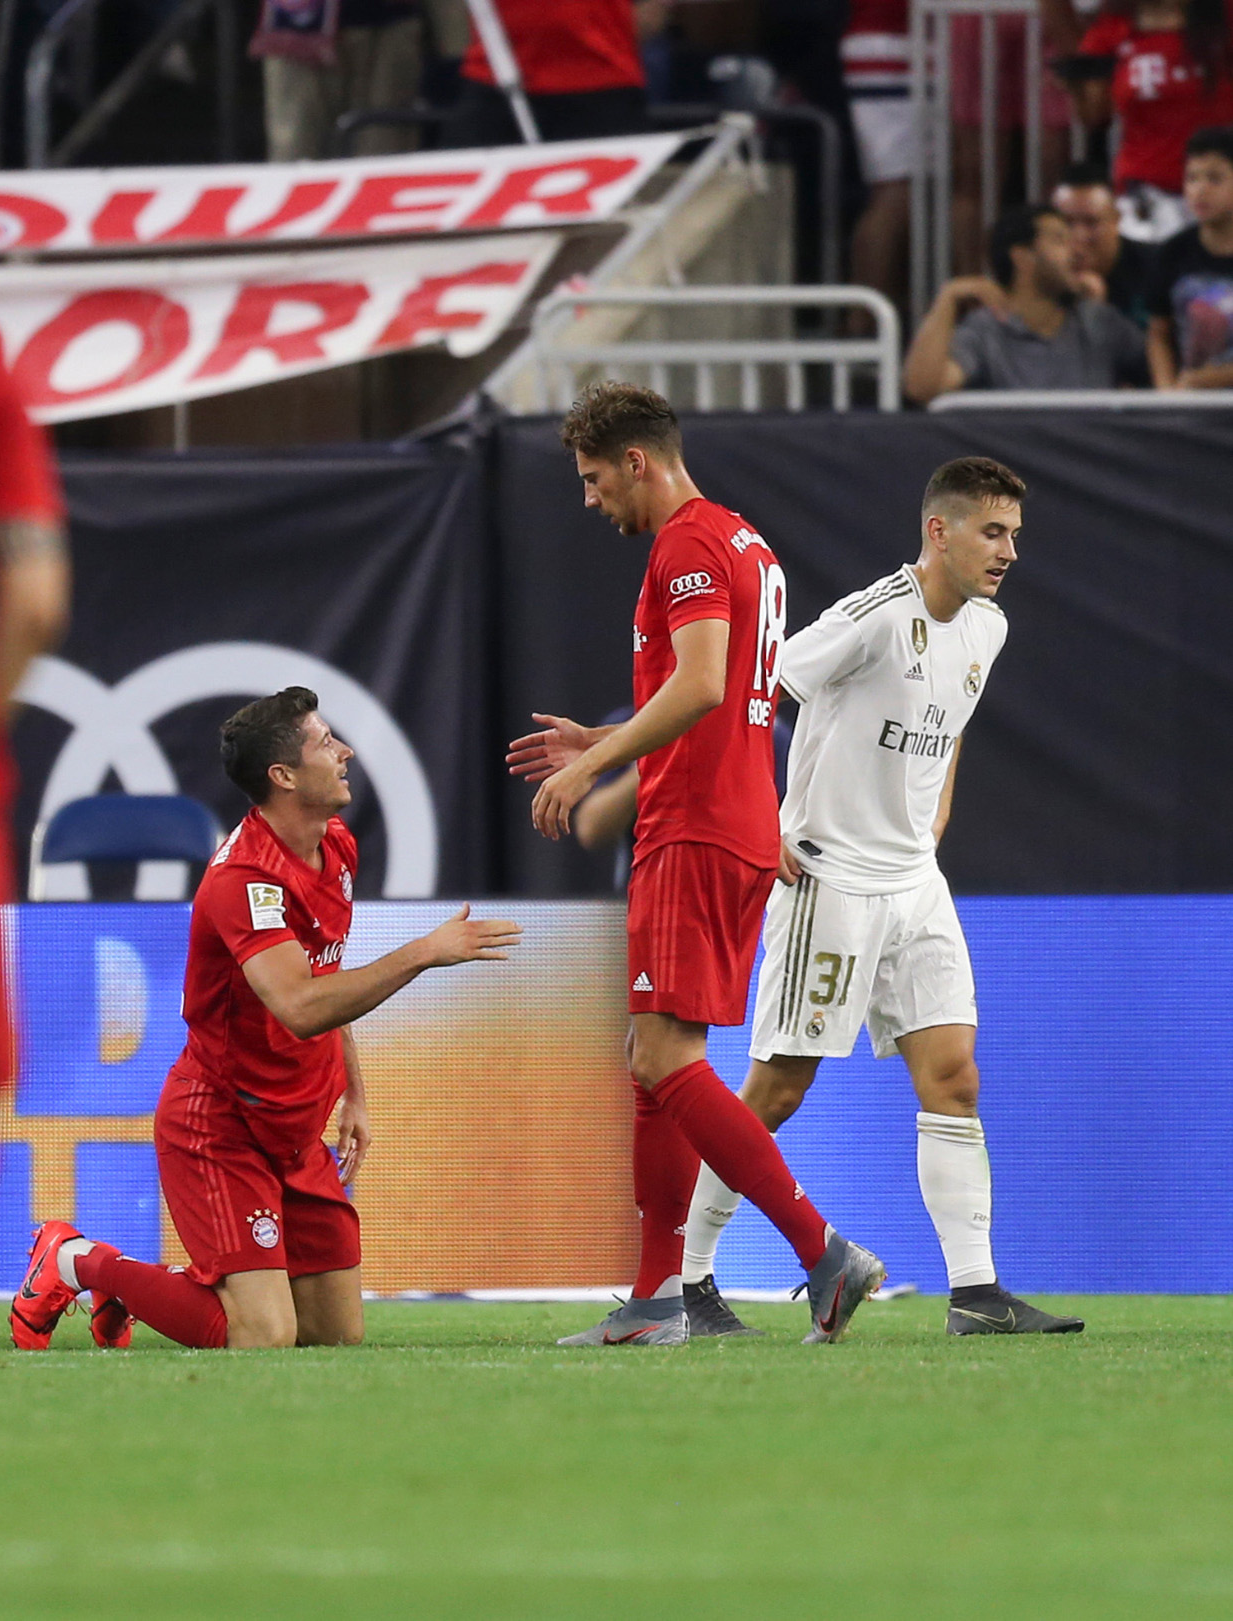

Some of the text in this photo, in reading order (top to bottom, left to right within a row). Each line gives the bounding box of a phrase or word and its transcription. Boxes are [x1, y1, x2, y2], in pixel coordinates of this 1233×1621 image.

[752, 559, 787, 699] 18
[923, 704, 946, 729] Fly
[808, 951, 857, 1007] 31
